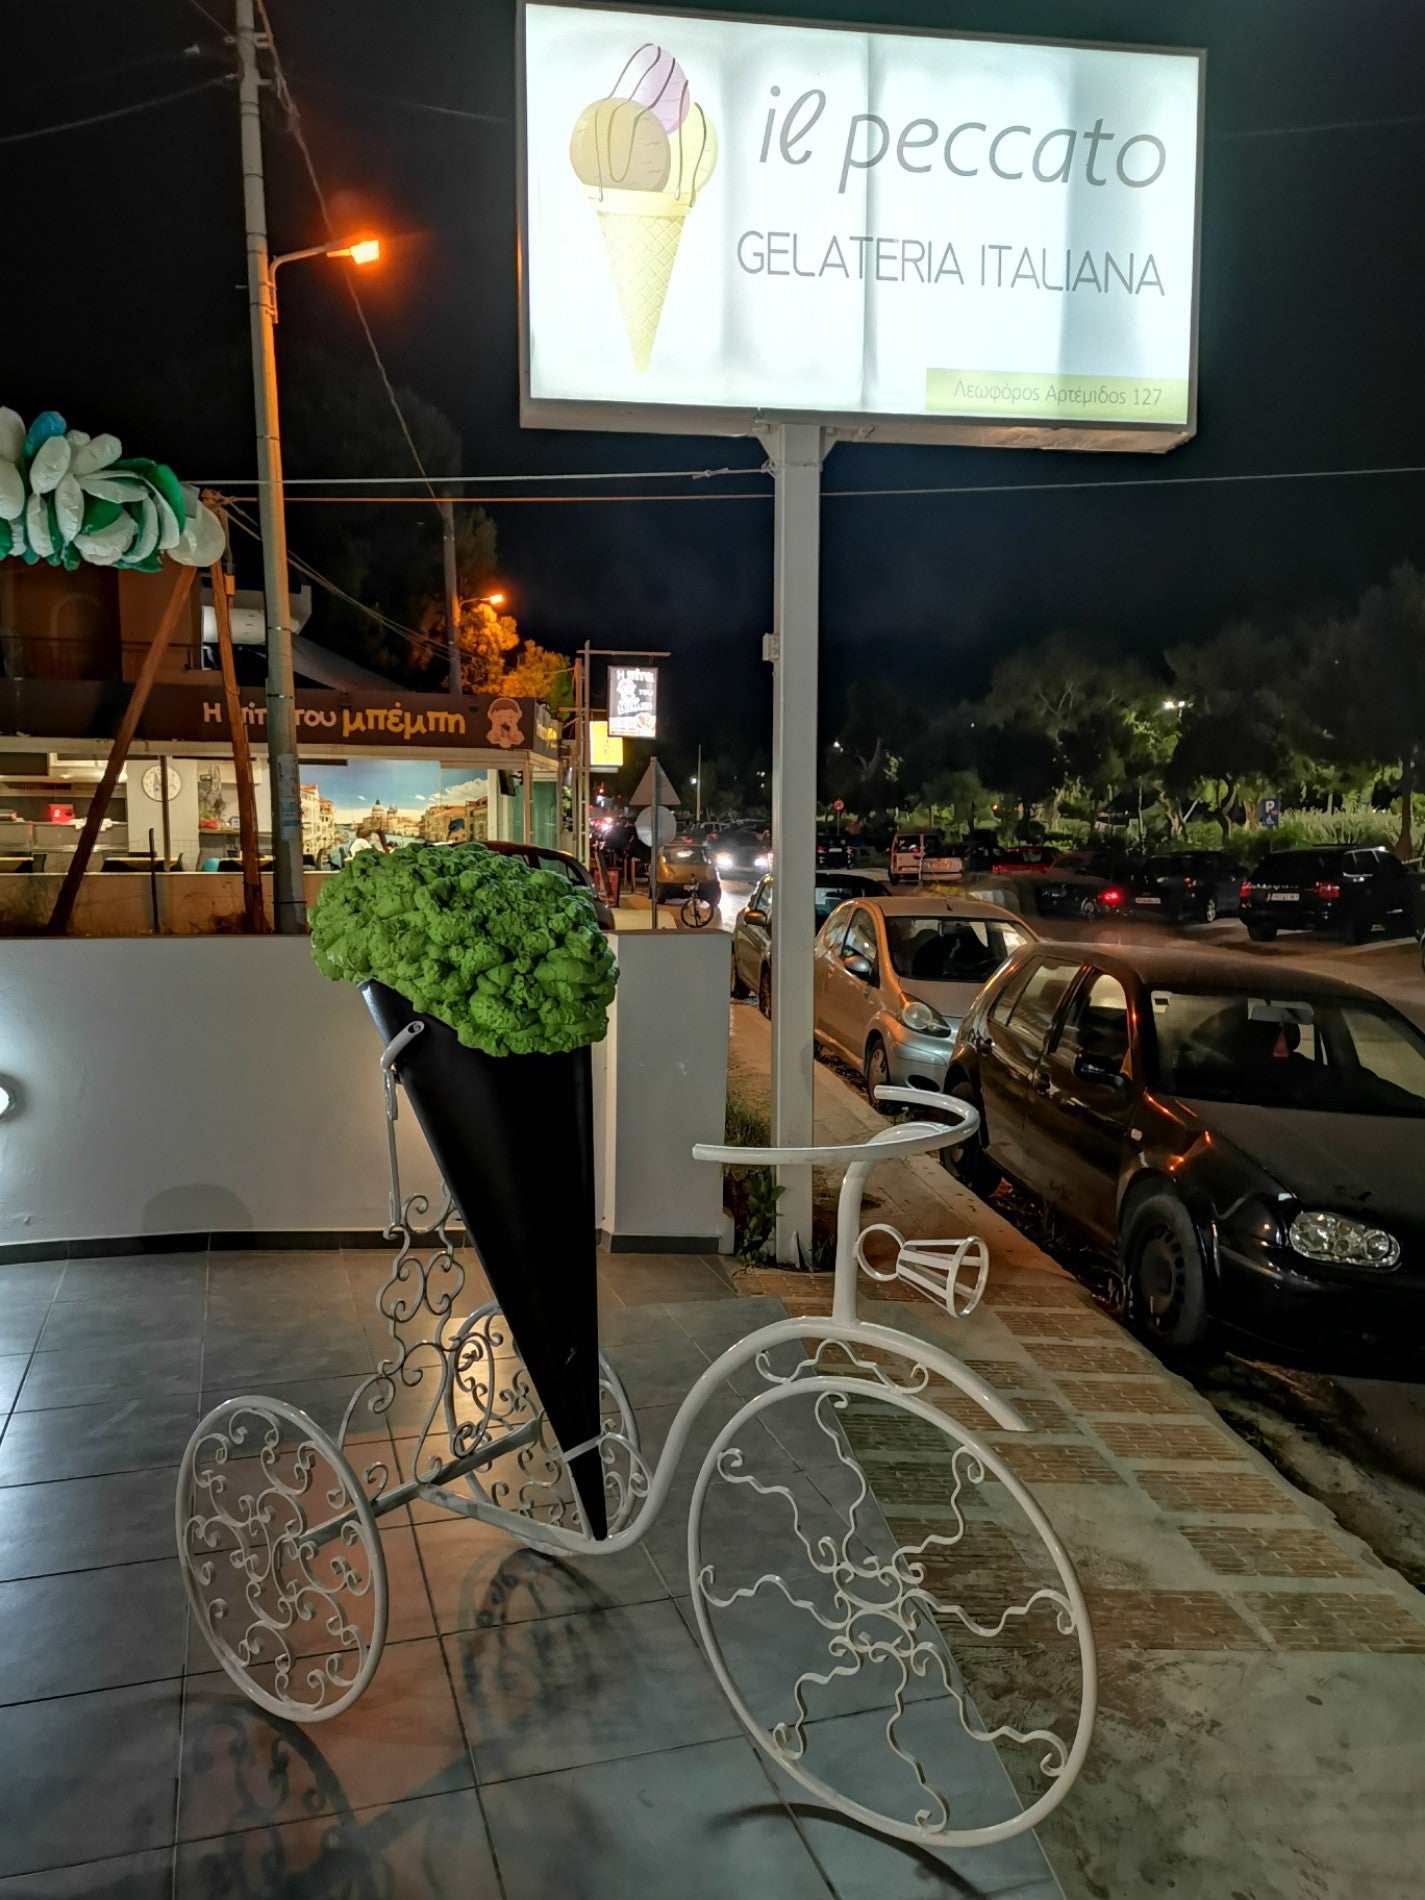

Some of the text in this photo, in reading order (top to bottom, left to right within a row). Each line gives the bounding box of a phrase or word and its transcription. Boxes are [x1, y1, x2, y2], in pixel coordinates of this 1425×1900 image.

[759, 85, 1167, 194] il peccato
[738, 230, 1165, 296] GELATERIA ITALIANA
[953, 380, 1163, 407] Λεωφόρος Αρτέμιδος 127
[342, 701, 466, 740] μπέμπη
